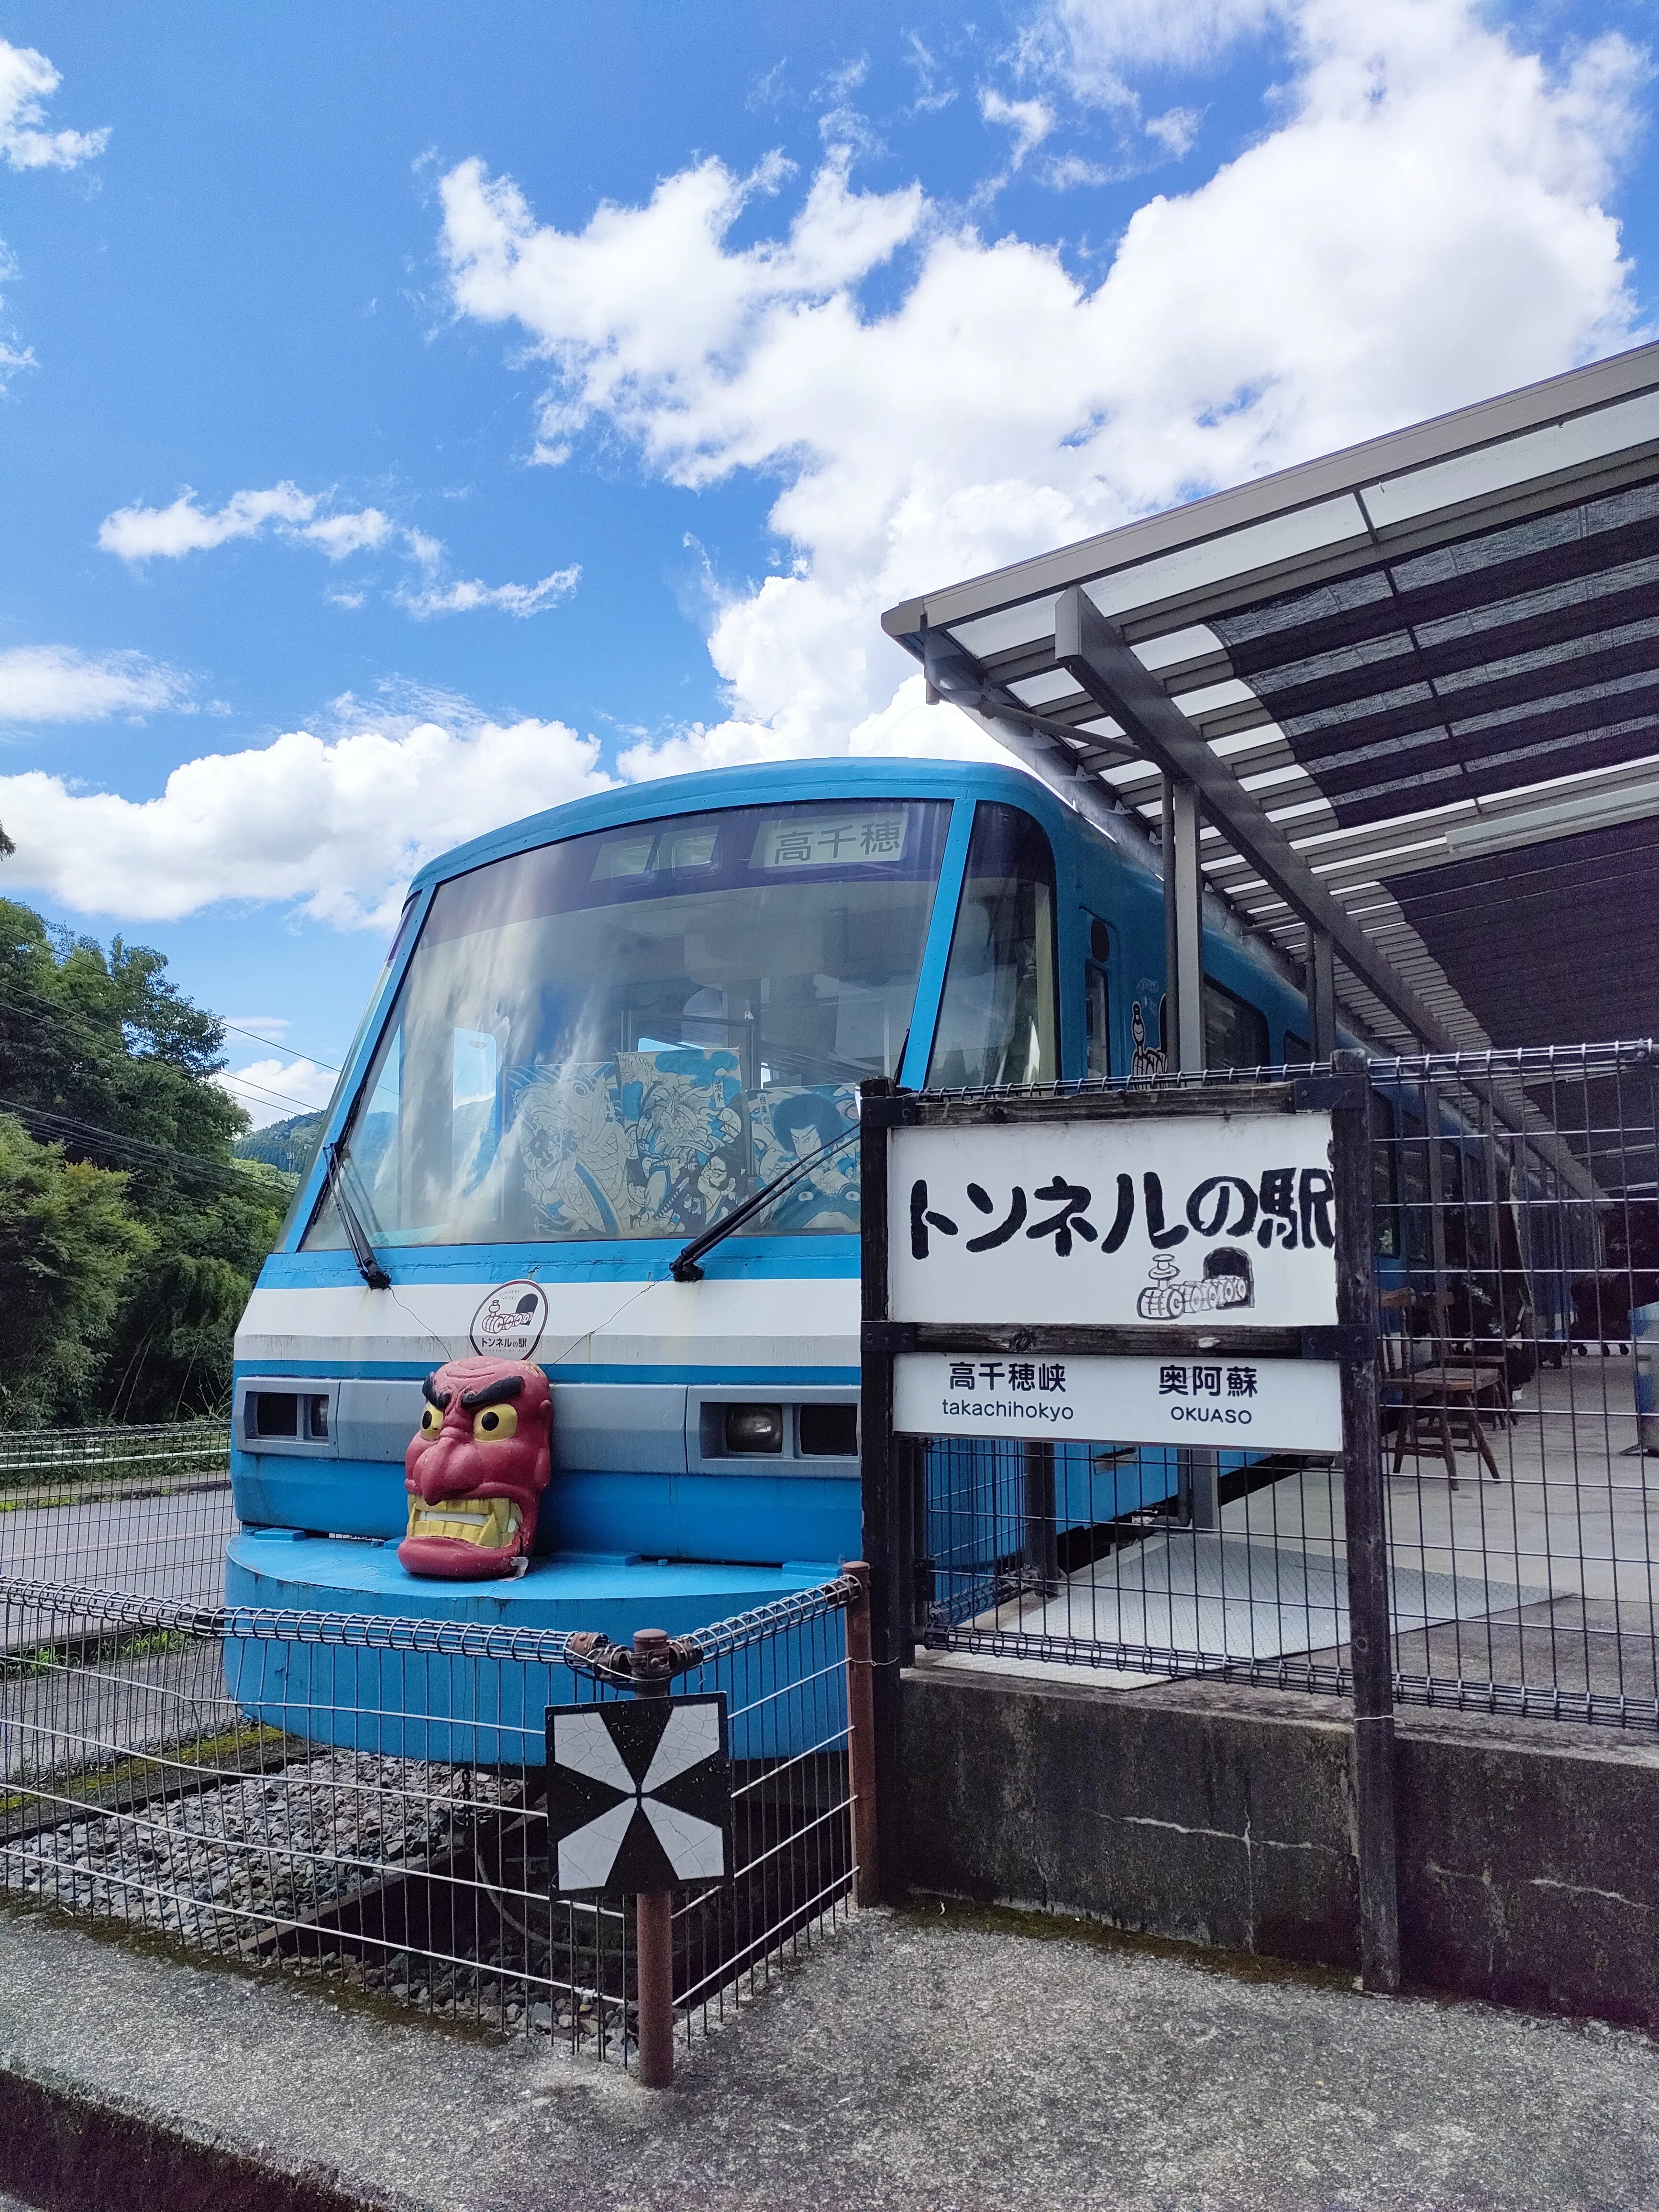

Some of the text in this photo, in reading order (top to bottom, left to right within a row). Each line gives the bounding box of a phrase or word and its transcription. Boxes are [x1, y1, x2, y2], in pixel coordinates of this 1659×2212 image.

[774, 819, 902, 864] 高千穂
[714, 1079, 723, 1103] 茨木
[910, 1167, 1335, 1260] トンネルの駅
[482, 1338, 527, 1348] トンネルの駅
[949, 1361, 1066, 1393] 高千穂峡
[1159, 1364, 1258, 1398] 奥阿蘇
[942, 1398, 1073, 1422] takachihokyo
[1171, 1406, 1252, 1425] OKUASO
